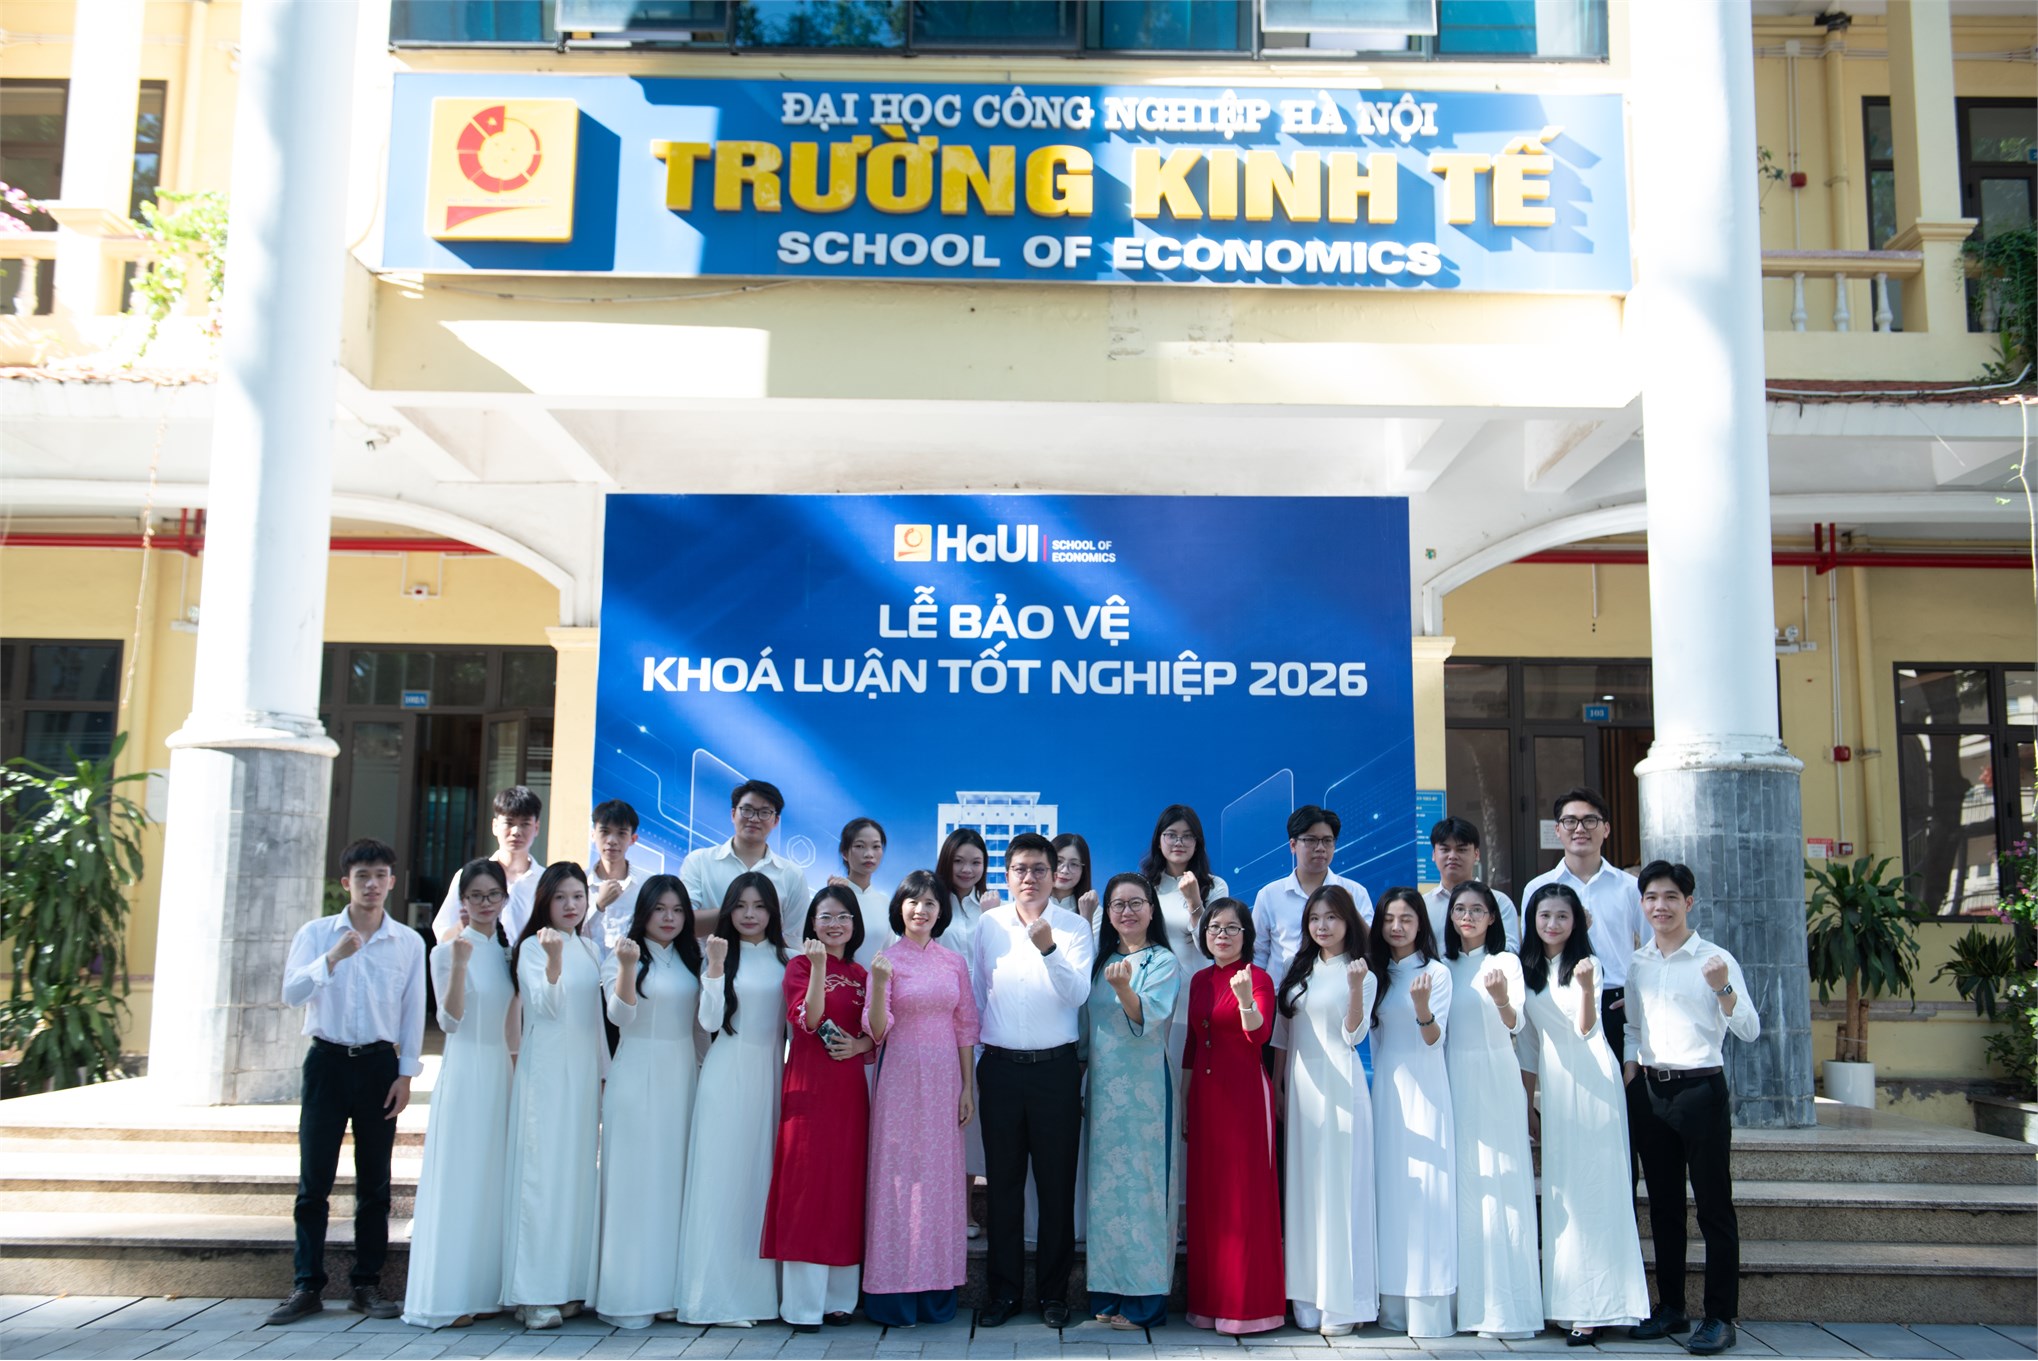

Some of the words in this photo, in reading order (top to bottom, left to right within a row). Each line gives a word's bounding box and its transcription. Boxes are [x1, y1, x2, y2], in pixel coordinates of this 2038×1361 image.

[781, 92, 859, 131] ĐẠI
[870, 92, 962, 133] HỌC
[973, 86, 1094, 130] CÔNG
[1104, 88, 1271, 141] NGHIỆP
[1281, 90, 1347, 134] HÀ
[1357, 92, 1439, 144] NỘI
[651, 125, 1094, 217] TRƯỜNG
[1131, 147, 1399, 224] KINH
[1428, 125, 1565, 228] TẾ
[777, 231, 1001, 267] SCHOOL
[1023, 235, 1092, 269] OF
[1113, 236, 1443, 276] ECONOMICS
[936, 524, 1039, 563] HaUI
[1051, 540, 1096, 550] SCHOOL
[1098, 540, 1113, 550] OF
[1051, 552, 1117, 563] ECONOMICS
[879, 585, 938, 638] LỄ
[949, 593, 1054, 640] BẢO
[1063, 594, 1130, 646] VỆ
[642, 646, 784, 692] KHOÁ
[794, 647, 927, 700] LUẬN
[938, 640, 1041, 694] TỐT
[1051, 649, 1237, 702] NGHIỆP
[1248, 661, 1368, 697] 2026
